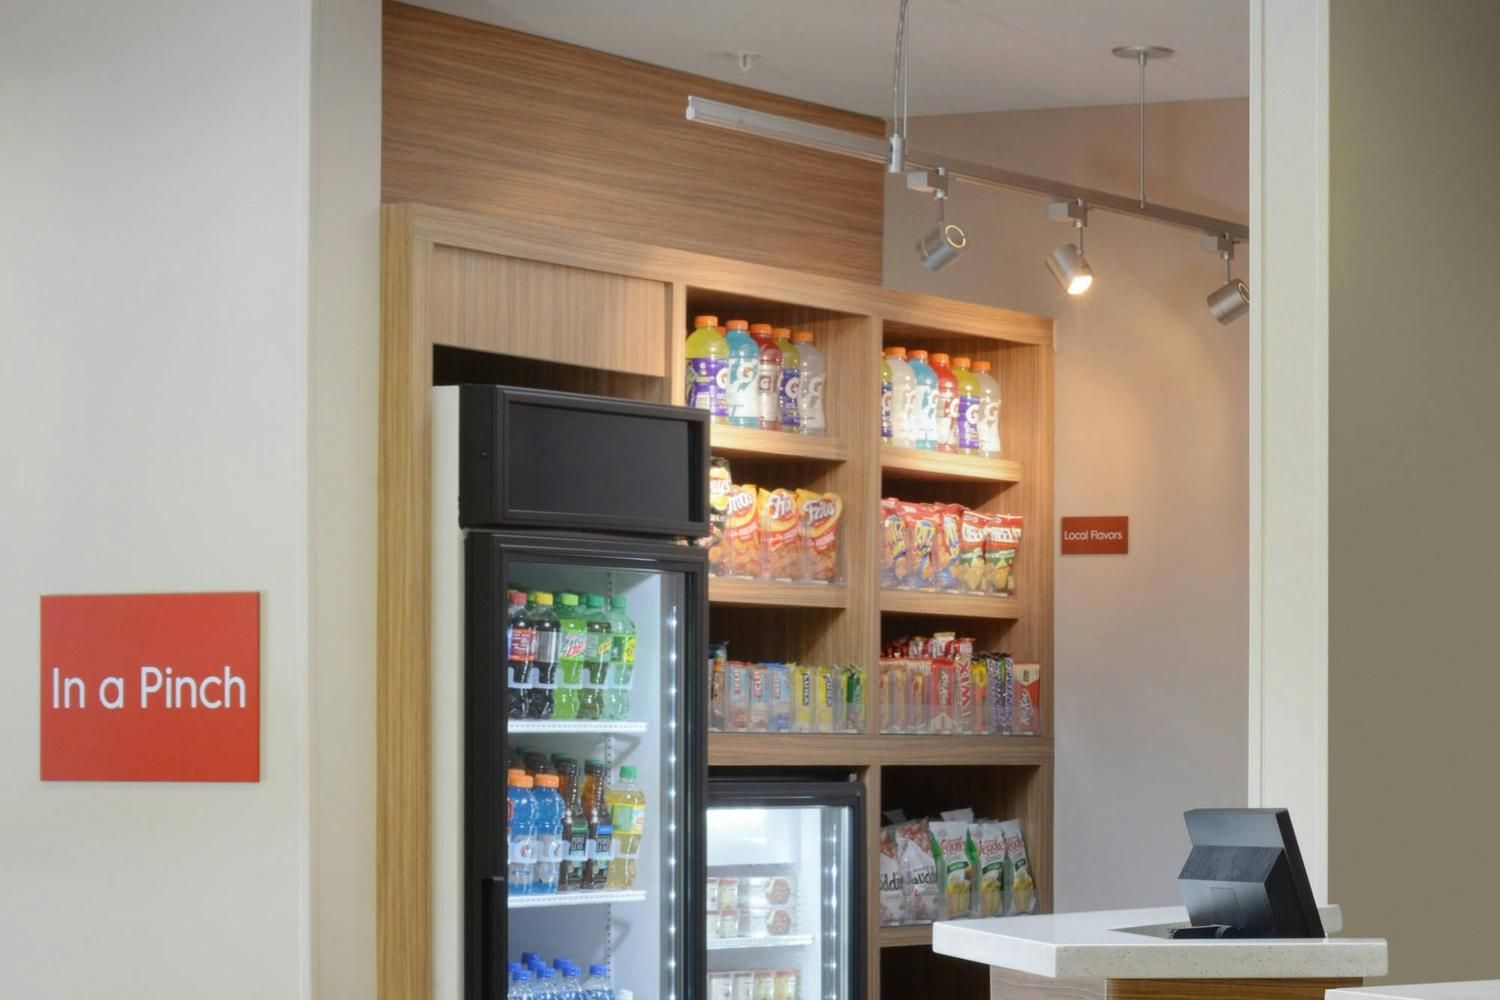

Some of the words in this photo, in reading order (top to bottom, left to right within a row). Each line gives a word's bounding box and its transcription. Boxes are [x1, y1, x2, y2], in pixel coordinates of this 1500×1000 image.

[1064, 530, 1089, 540] Local
[1090, 529, 1123, 540] Flavors
[52, 666, 85, 709] In
[98, 676, 124, 709] a
[140, 665, 247, 709] Pinch
